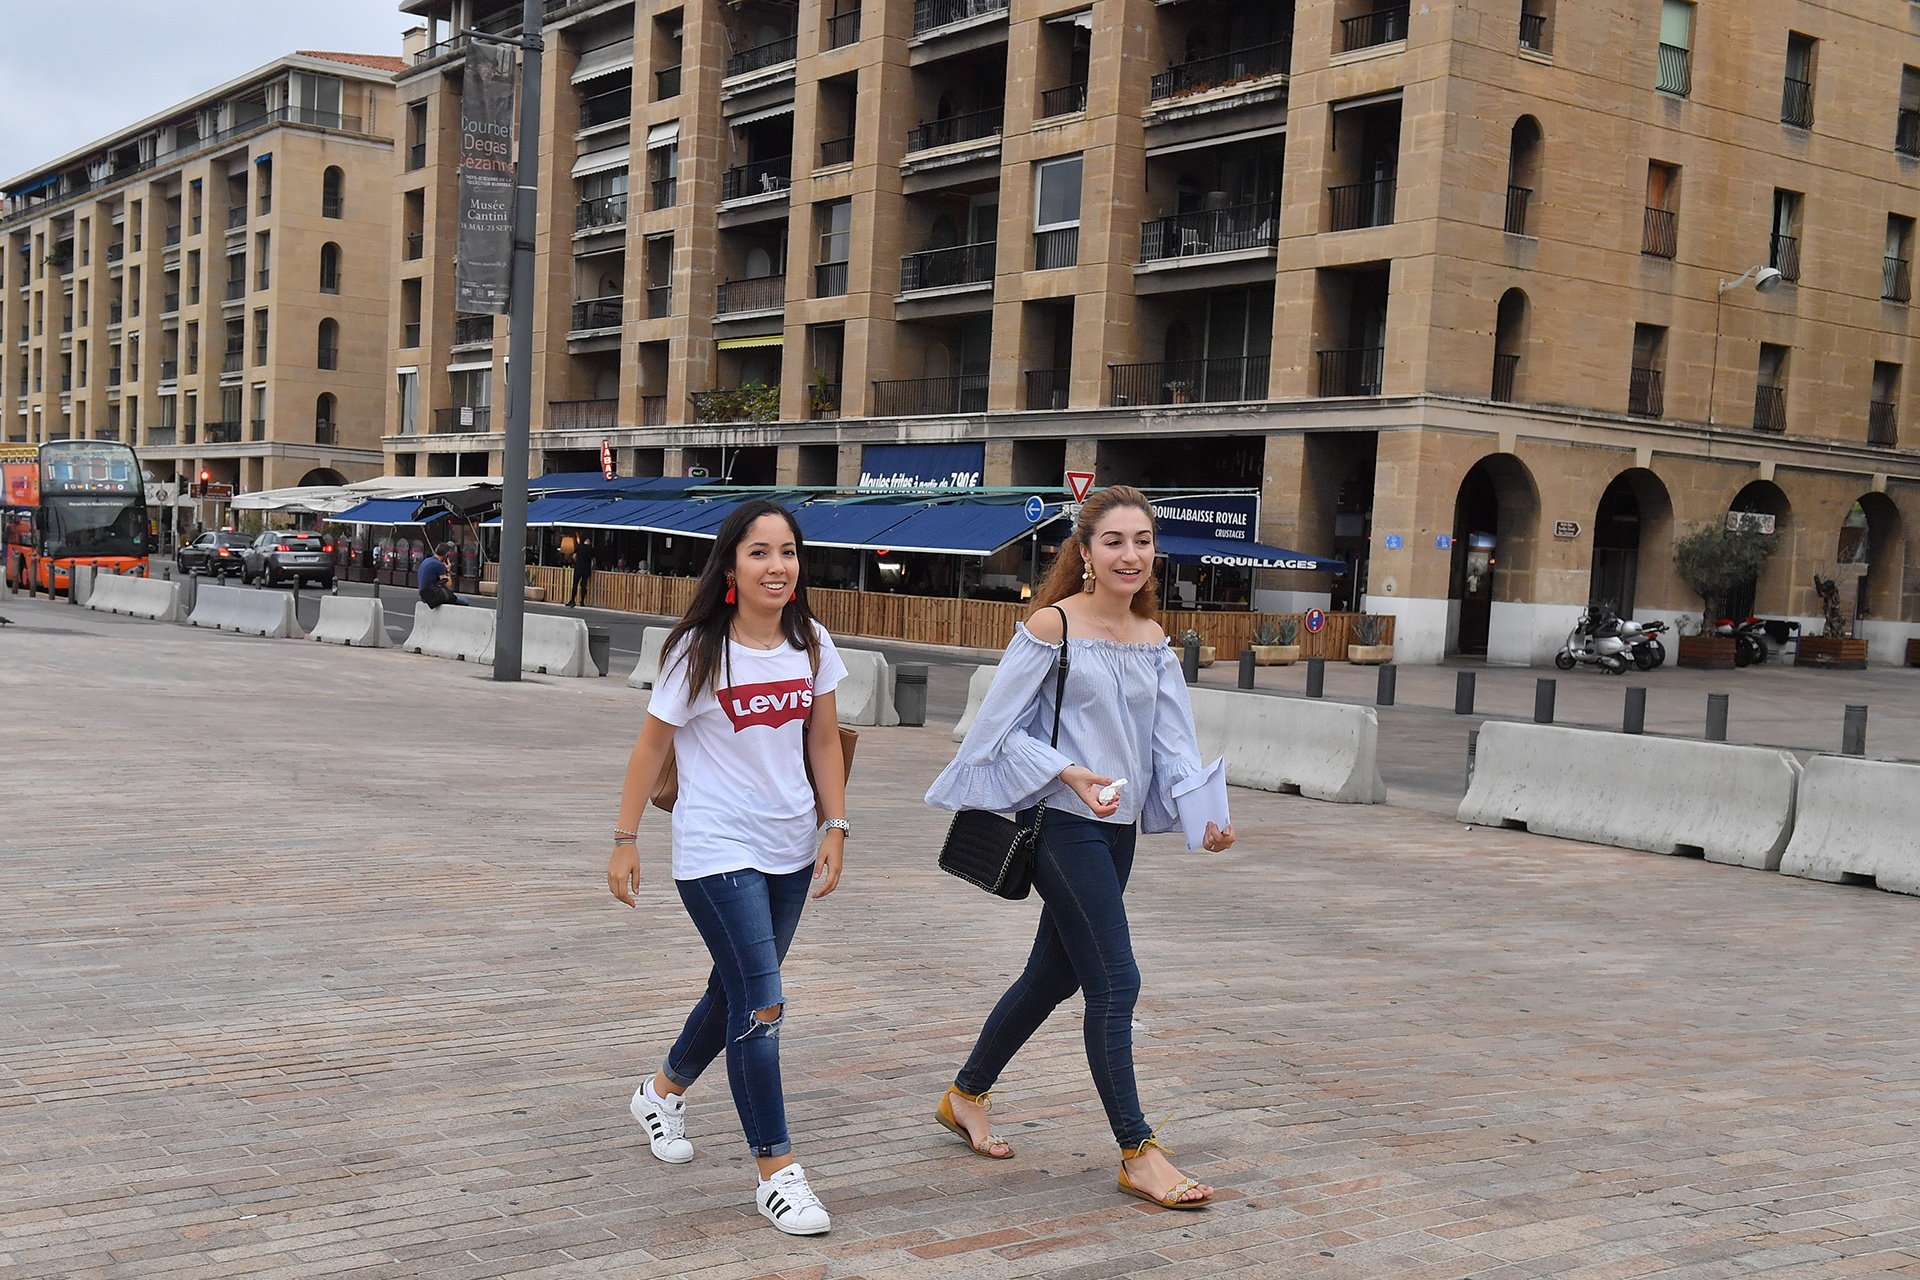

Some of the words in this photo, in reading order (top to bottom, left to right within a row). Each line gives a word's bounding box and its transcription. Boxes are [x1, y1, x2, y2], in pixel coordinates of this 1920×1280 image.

[461, 116, 514, 139] Courbet
[464, 133, 508, 156] Degas
[470, 198, 506, 211] Musée
[467, 209, 508, 221] Cantini
[603, 441, 612, 480] TABAC
[1152, 505, 1214, 523] BOUILLABAISSE
[1216, 510, 1248, 526] ROYALE
[1214, 528, 1246, 540] CRUSTACES
[1200, 555, 1318, 570] COQUILLAGES
